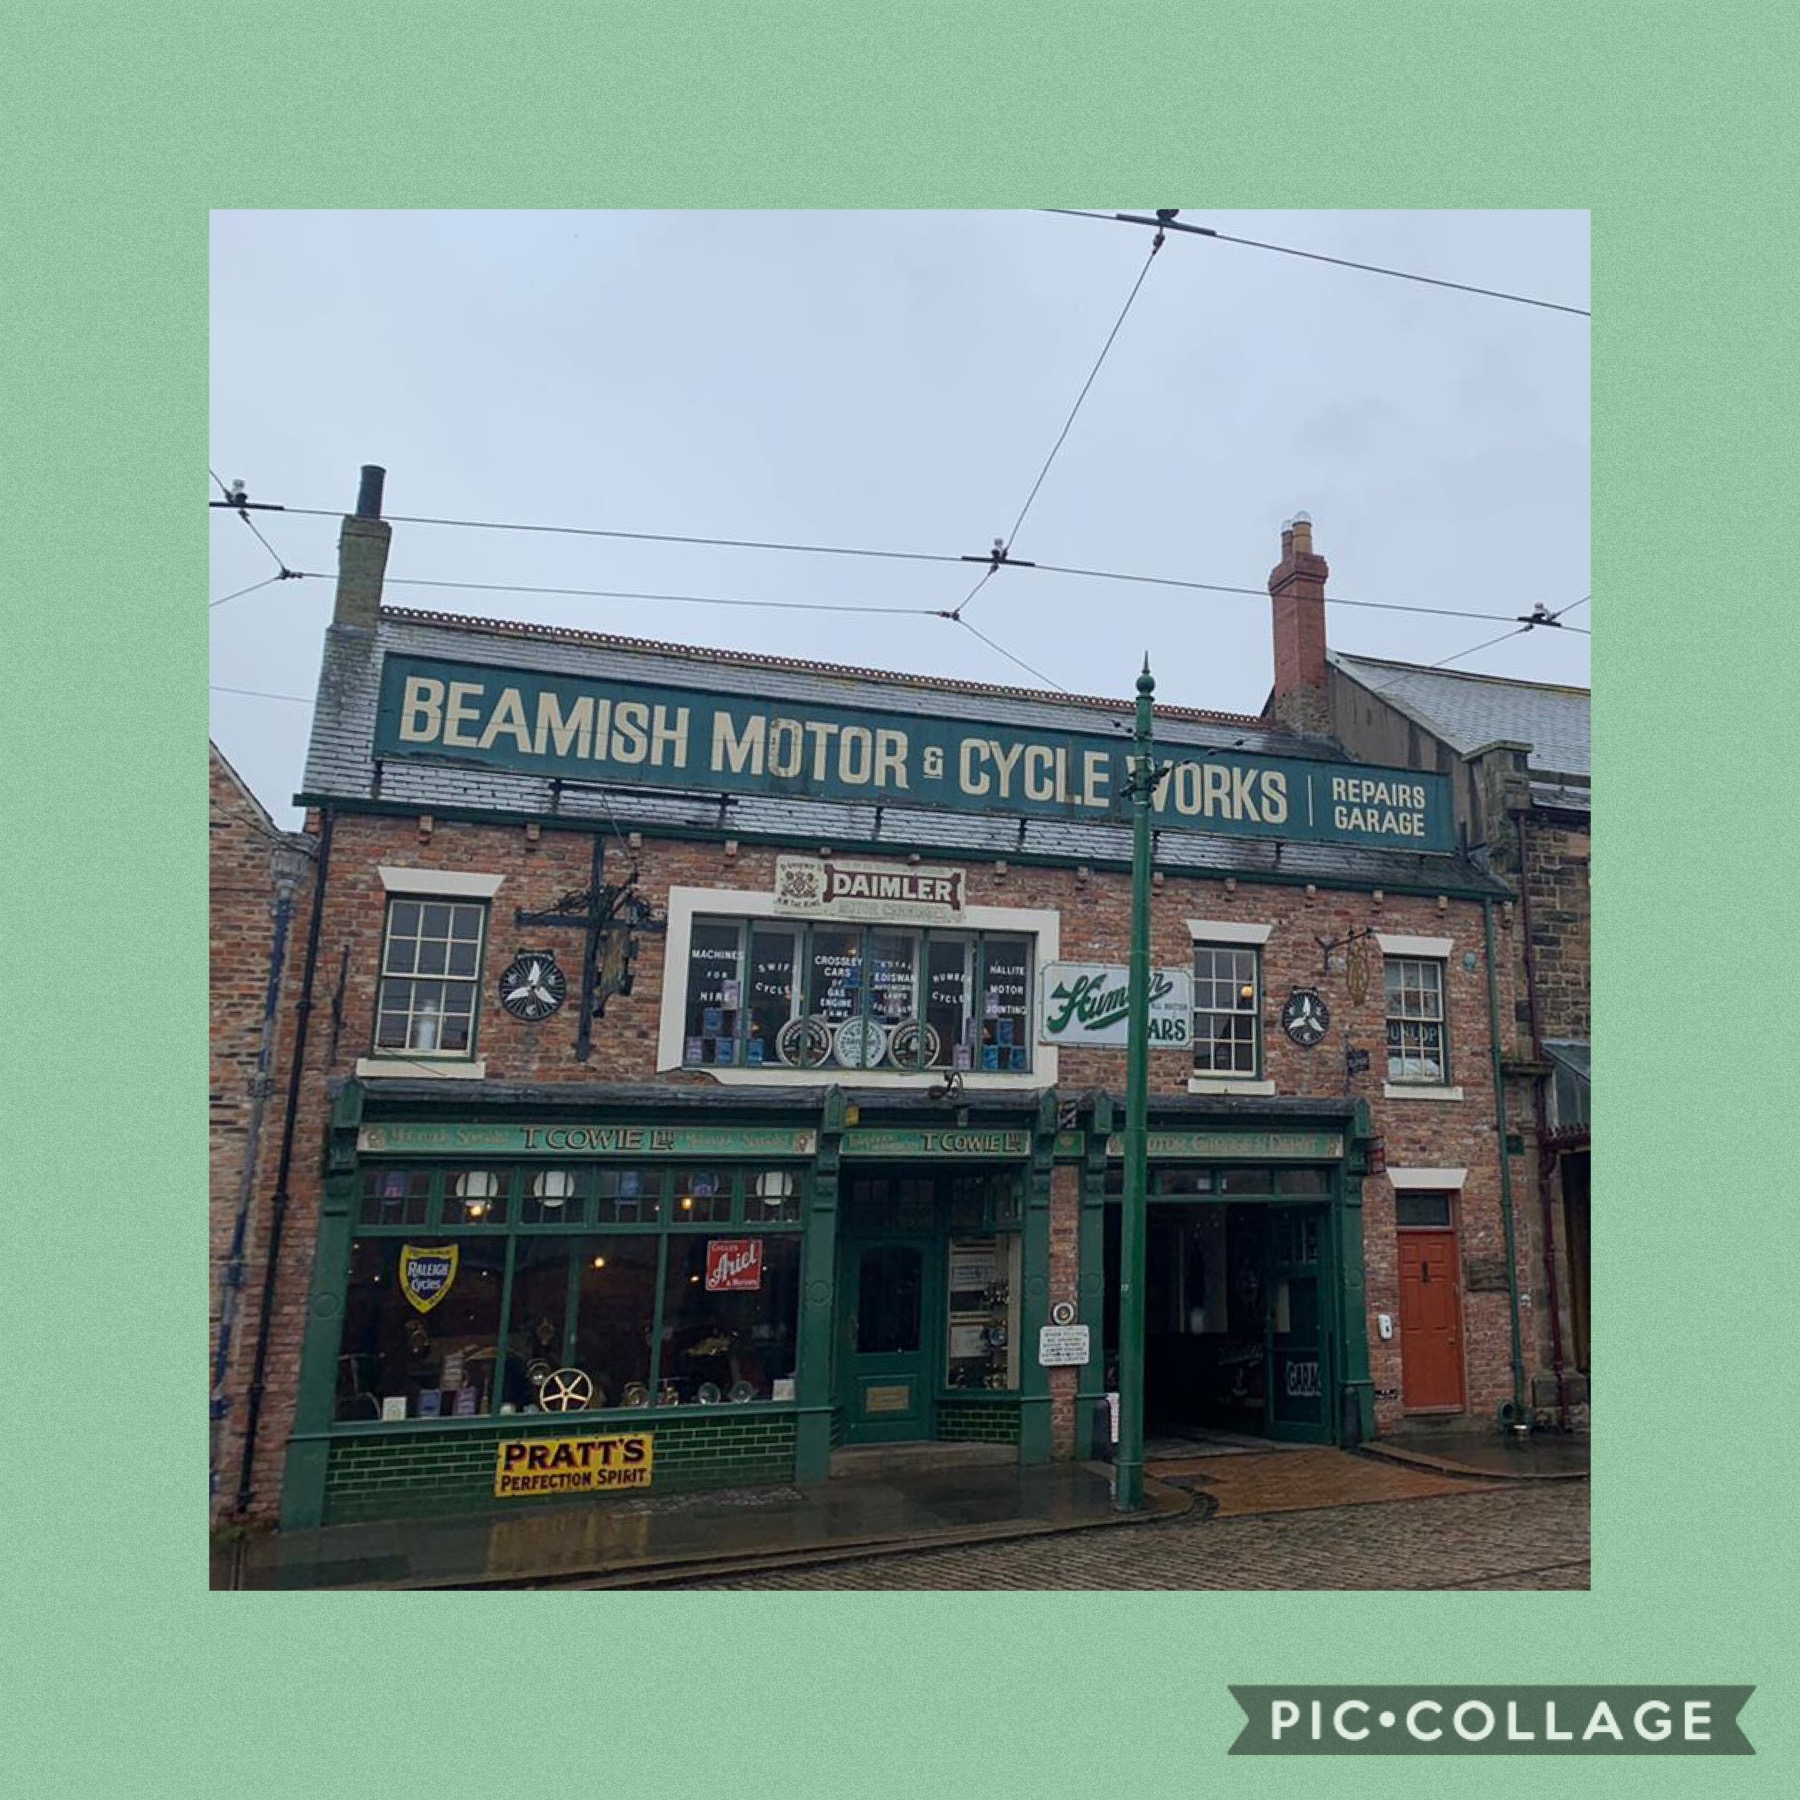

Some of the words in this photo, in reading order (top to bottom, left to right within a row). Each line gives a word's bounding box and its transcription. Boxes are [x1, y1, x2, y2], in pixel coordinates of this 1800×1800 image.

[399, 675, 690, 768] BEAMISH
[711, 711, 909, 789] MOTOR
[923, 746, 944, 778] &
[958, 738, 1111, 808] CYCLE
[1332, 777, 1426, 809] REPAIRS
[1334, 806, 1426, 838] GARAGE
[832, 872, 952, 902] DAIMLER
[815, 955, 863, 967] CROSSLEY
[824, 967, 852, 978] CARS
[990, 965, 1025, 975] HALLITE
[706, 971, 729, 980] FOR
[989, 985, 1024, 996] MOTOR
[1147, 1017, 1187, 1042] ARS
[545, 1128, 644, 1151] COWIE
[943, 1133, 1001, 1153] COWIE
[708, 1243, 758, 1288] Ariel
[504, 1438, 645, 1472] PRATT'S
[501, 1471, 592, 1493] PERFECTION
[598, 1467, 647, 1487] SPIRIT
